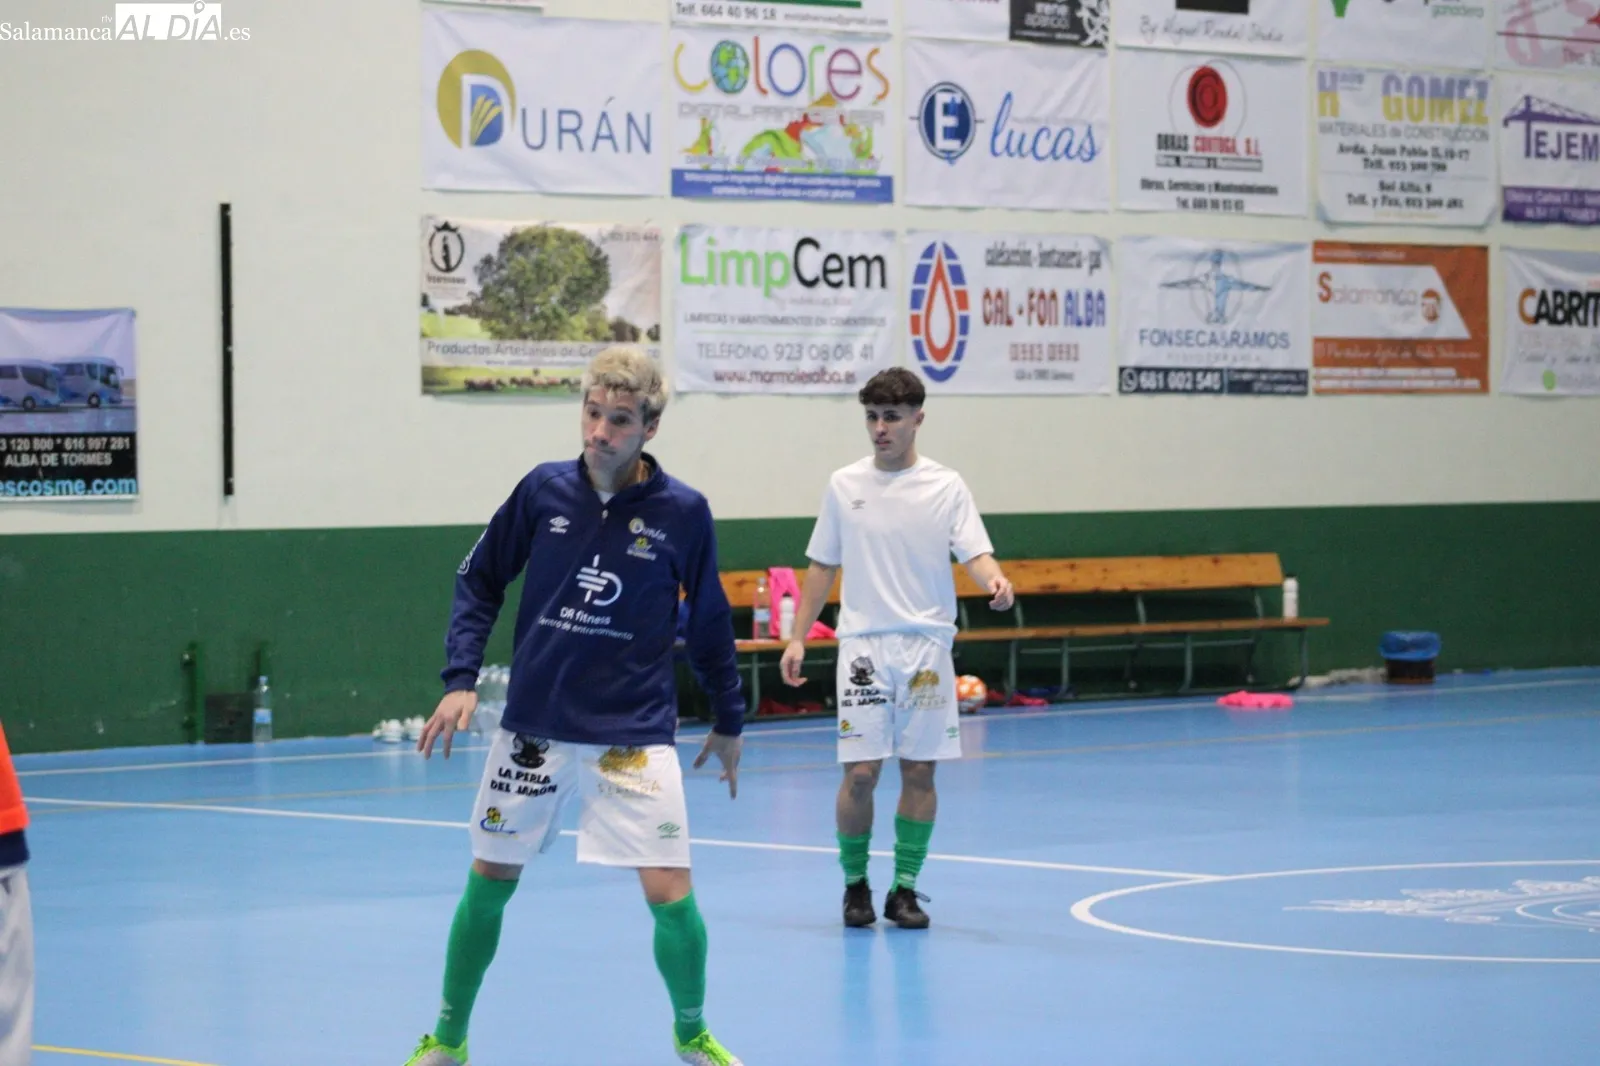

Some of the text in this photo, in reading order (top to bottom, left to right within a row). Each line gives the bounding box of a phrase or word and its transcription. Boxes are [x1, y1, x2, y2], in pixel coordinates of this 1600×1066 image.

[671, 34, 890, 101] colores
[990, 90, 1100, 163] lucas
[680, 231, 887, 299] LimpCem
[427, 340, 490, 356] Productos
[774, 343, 803, 361] 923
[10, 438, 31, 451] 120
[4, 453, 39, 467] ALBA
[61, 452, 113, 467] TORMES
[576, 610, 612, 625] fitness
[498, 766, 551, 784] LA PERLA
[490, 779, 512, 793] DEL
